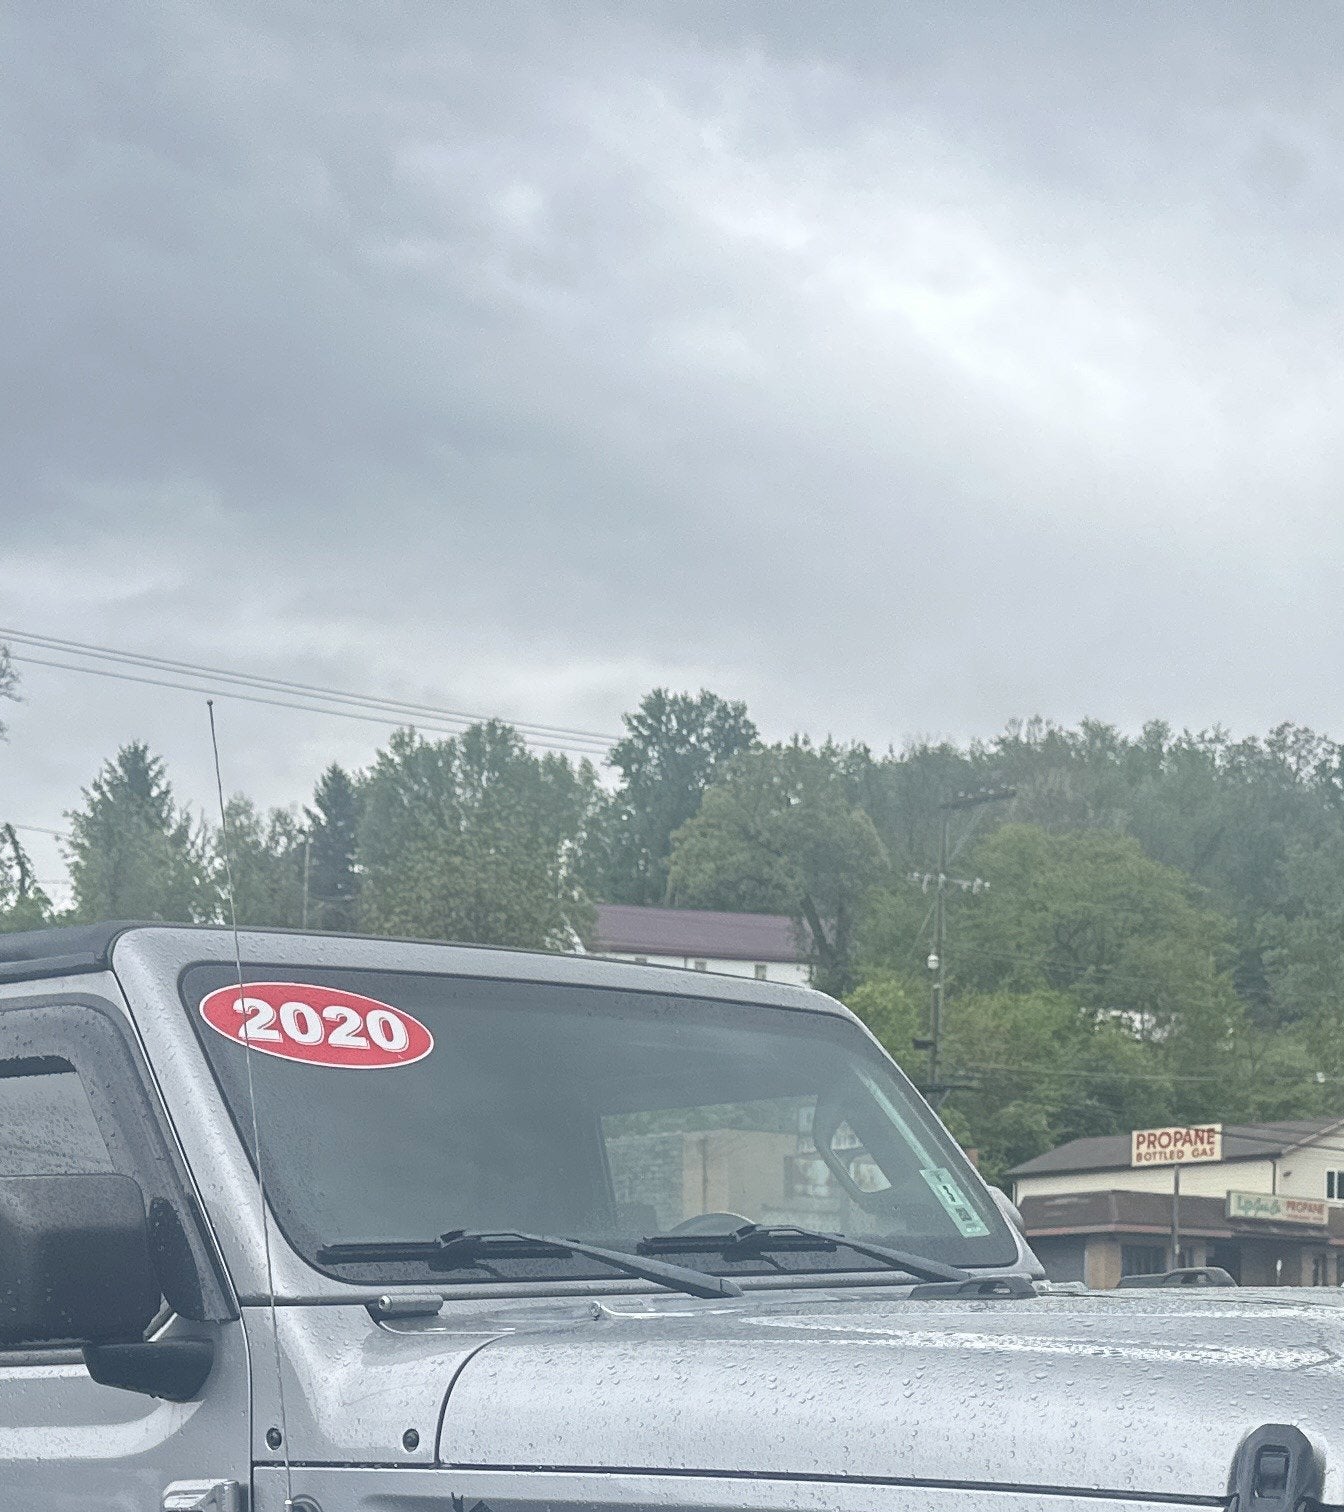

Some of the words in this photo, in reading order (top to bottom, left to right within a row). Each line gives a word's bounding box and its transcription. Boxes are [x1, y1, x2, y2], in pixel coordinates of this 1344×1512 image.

[232, 998, 410, 1053] 2020
[1136, 1128, 1216, 1150] PROPANE
[1136, 1150, 1185, 1162] BOTTLED
[1191, 1148, 1215, 1159] GAS
